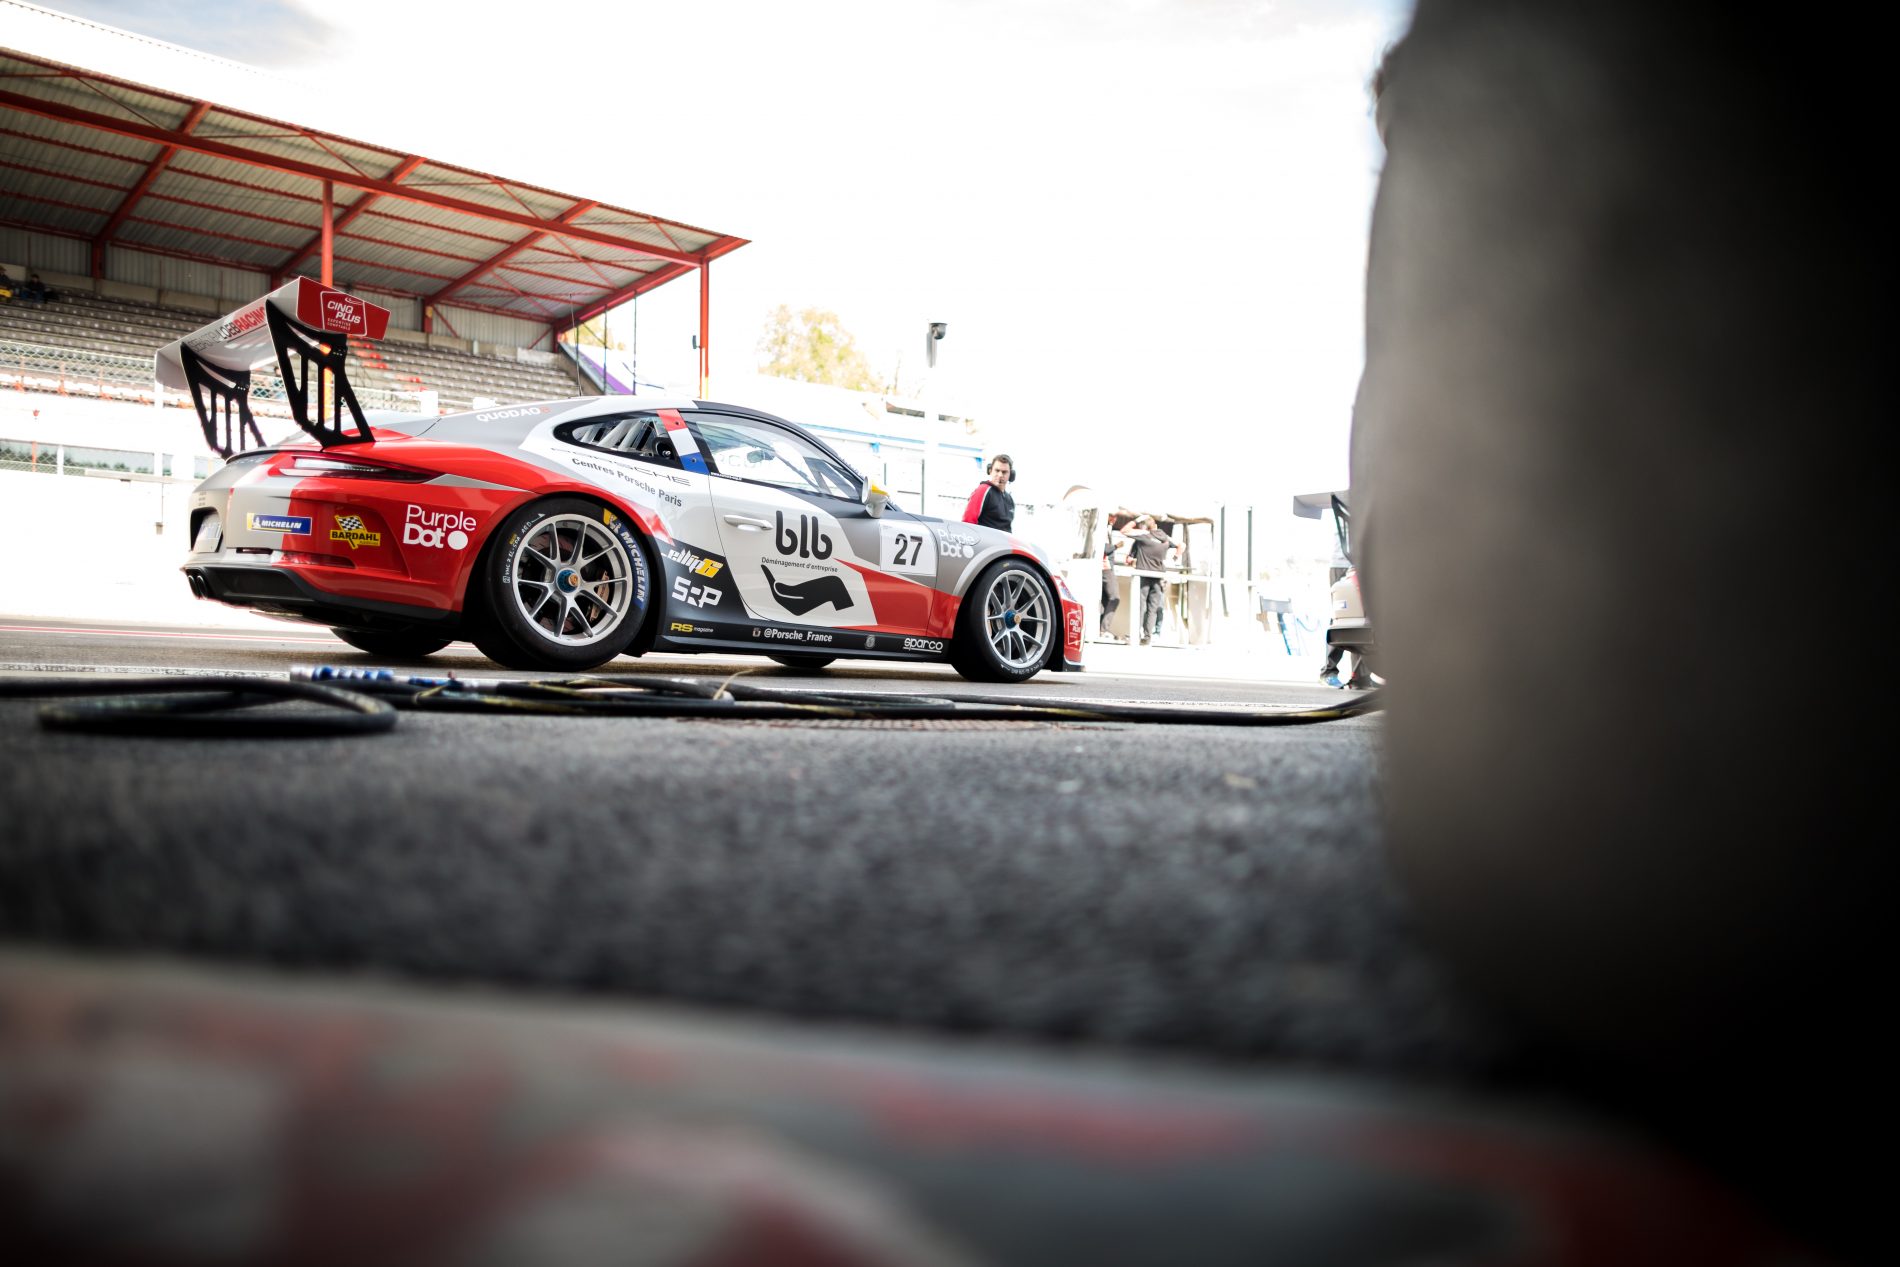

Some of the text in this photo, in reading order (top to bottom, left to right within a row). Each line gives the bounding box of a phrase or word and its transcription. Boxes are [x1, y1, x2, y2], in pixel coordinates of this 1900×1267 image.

[327, 300, 354, 314] CINQ
[336, 311, 361, 324] PLUS
[572, 457, 682, 507] Centres Porsche Paris
[261, 519, 302, 529] MICHELIN
[406, 504, 477, 531] Purple
[331, 531, 379, 541] BARDAHL
[403, 522, 446, 548] Dot
[776, 510, 833, 560] blb
[937, 529, 975, 546] Purple
[893, 533, 923, 566] 27
[940, 541, 962, 558] Dot
[620, 531, 646, 602] MICHELIN
[761, 557, 838, 573] Déménagement d'entreprise
[670, 622, 693, 632] RS
[764, 628, 833, 642] @Porsche_France
[904, 637, 943, 651] sparco
